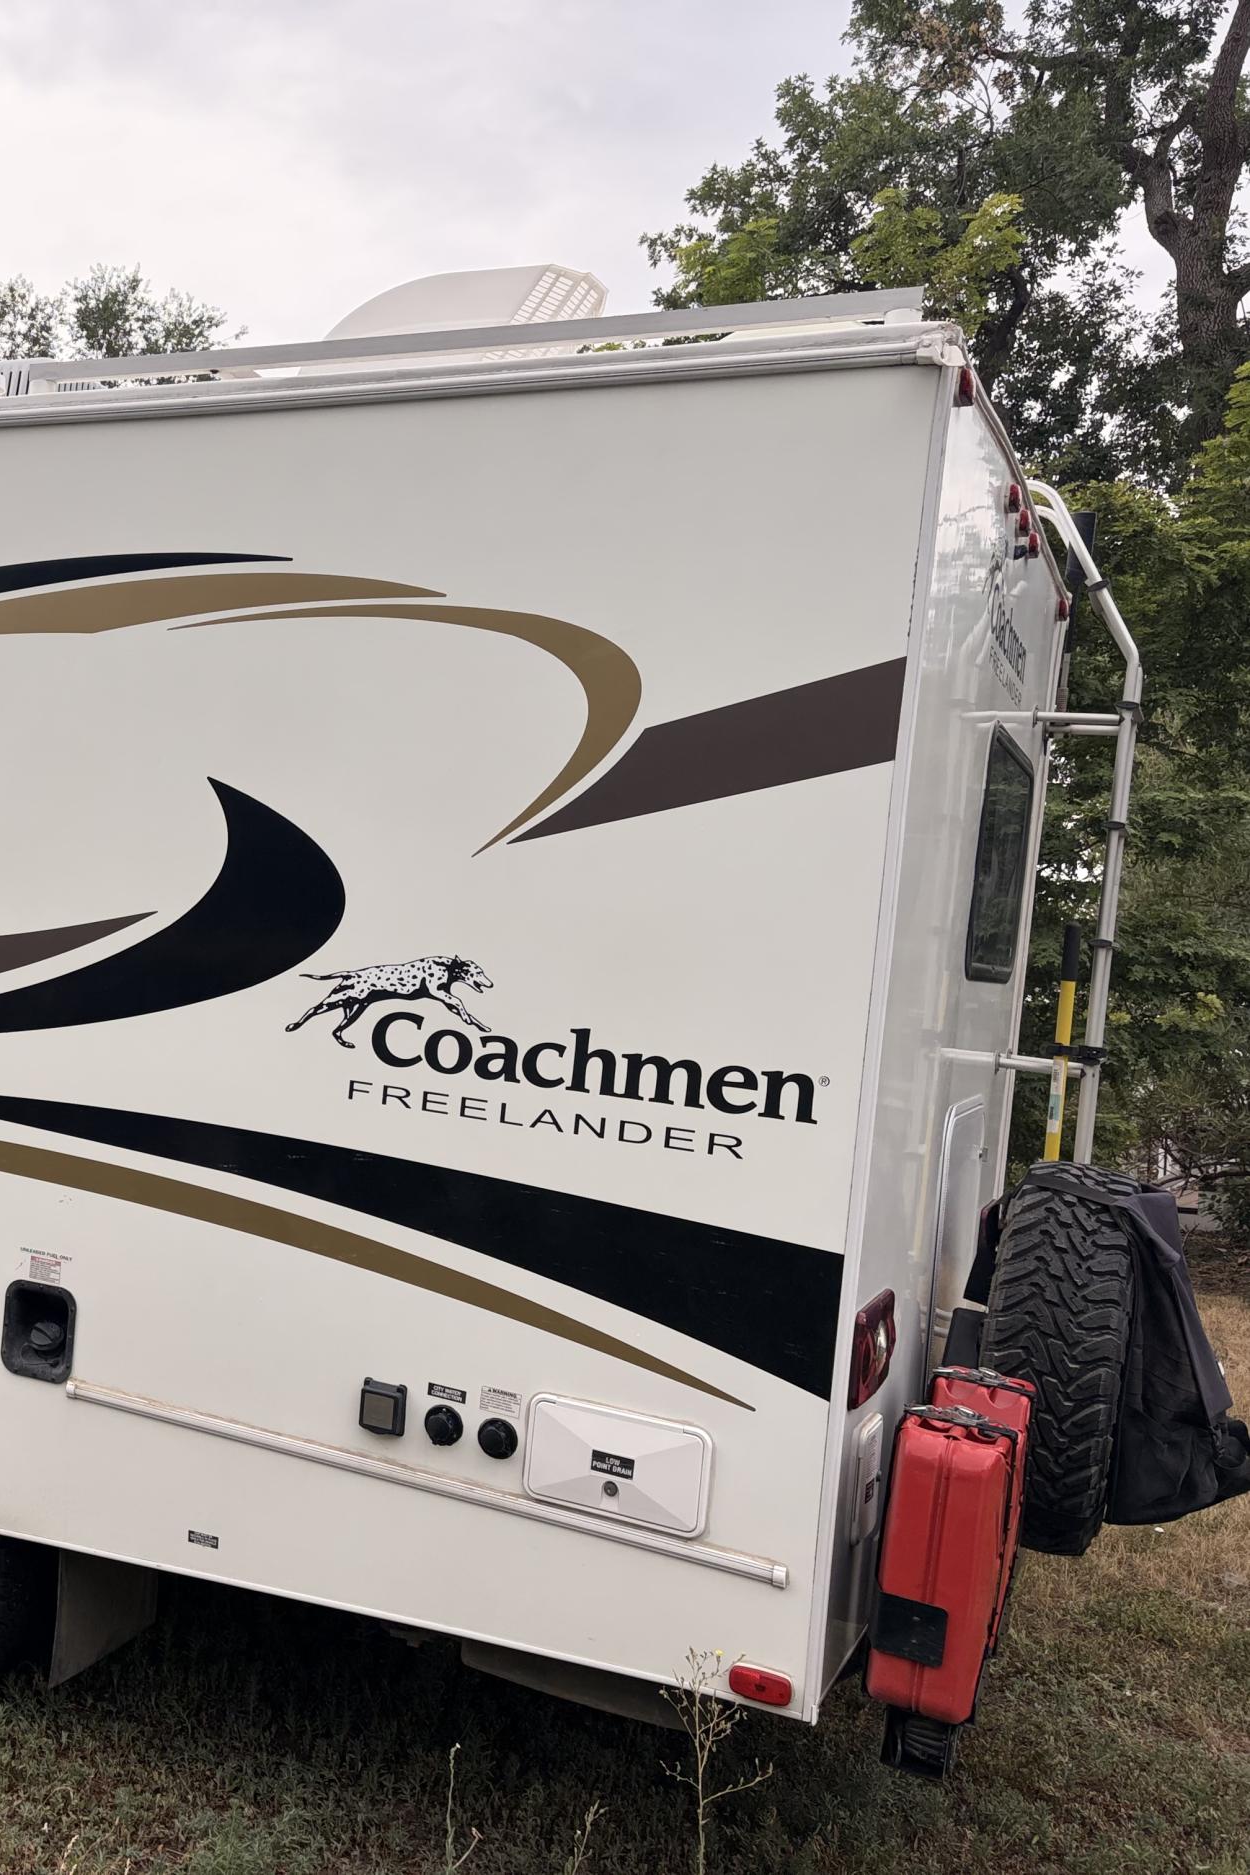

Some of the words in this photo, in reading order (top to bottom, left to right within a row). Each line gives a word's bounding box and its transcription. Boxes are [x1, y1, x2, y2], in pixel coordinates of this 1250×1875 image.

[371, 1011, 818, 1124] Coachmen
[346, 1079, 745, 1160] FREELANDER
[592, 1460, 611, 1471] POINT
[612, 1465, 633, 1477] DRAIN
[605, 1456, 621, 1466] LOW
